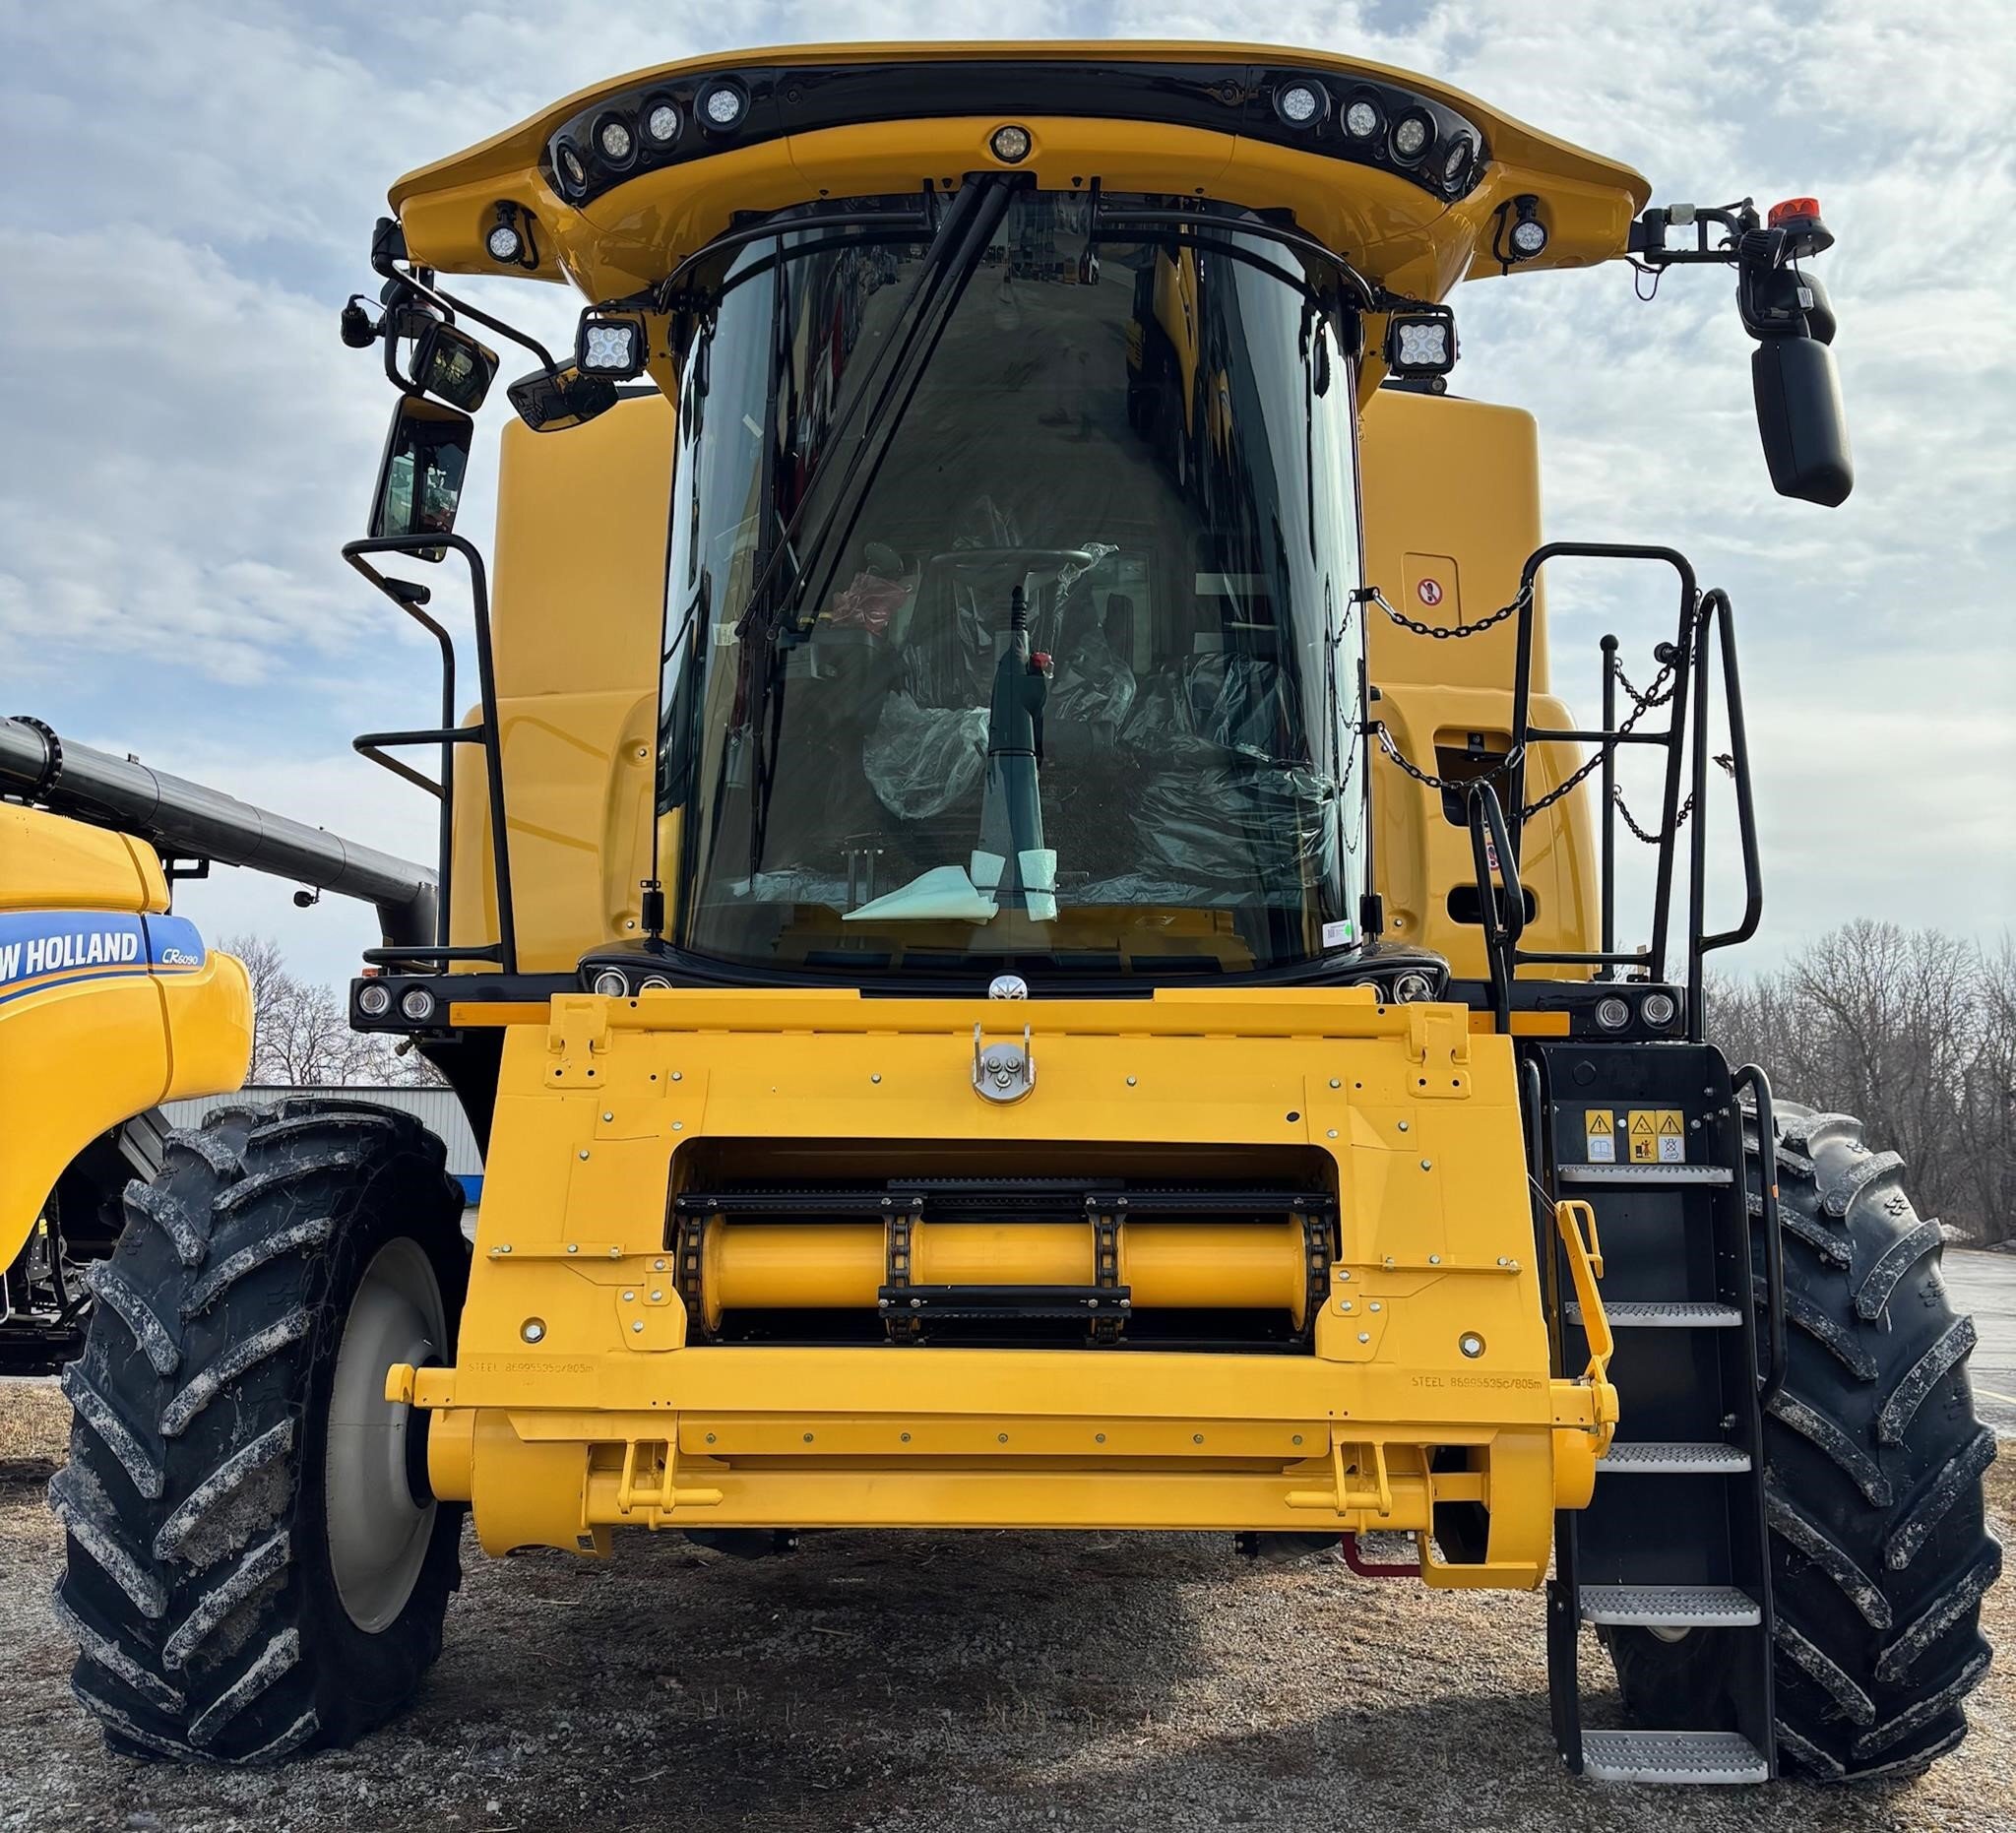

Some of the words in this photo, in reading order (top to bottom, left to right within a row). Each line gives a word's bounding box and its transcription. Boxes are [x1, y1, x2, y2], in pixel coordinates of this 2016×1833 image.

[26, 933, 139, 975] HOLLAND
[161, 948, 199, 966] CR6090
[1412, 1376, 1445, 1388] STEEL
